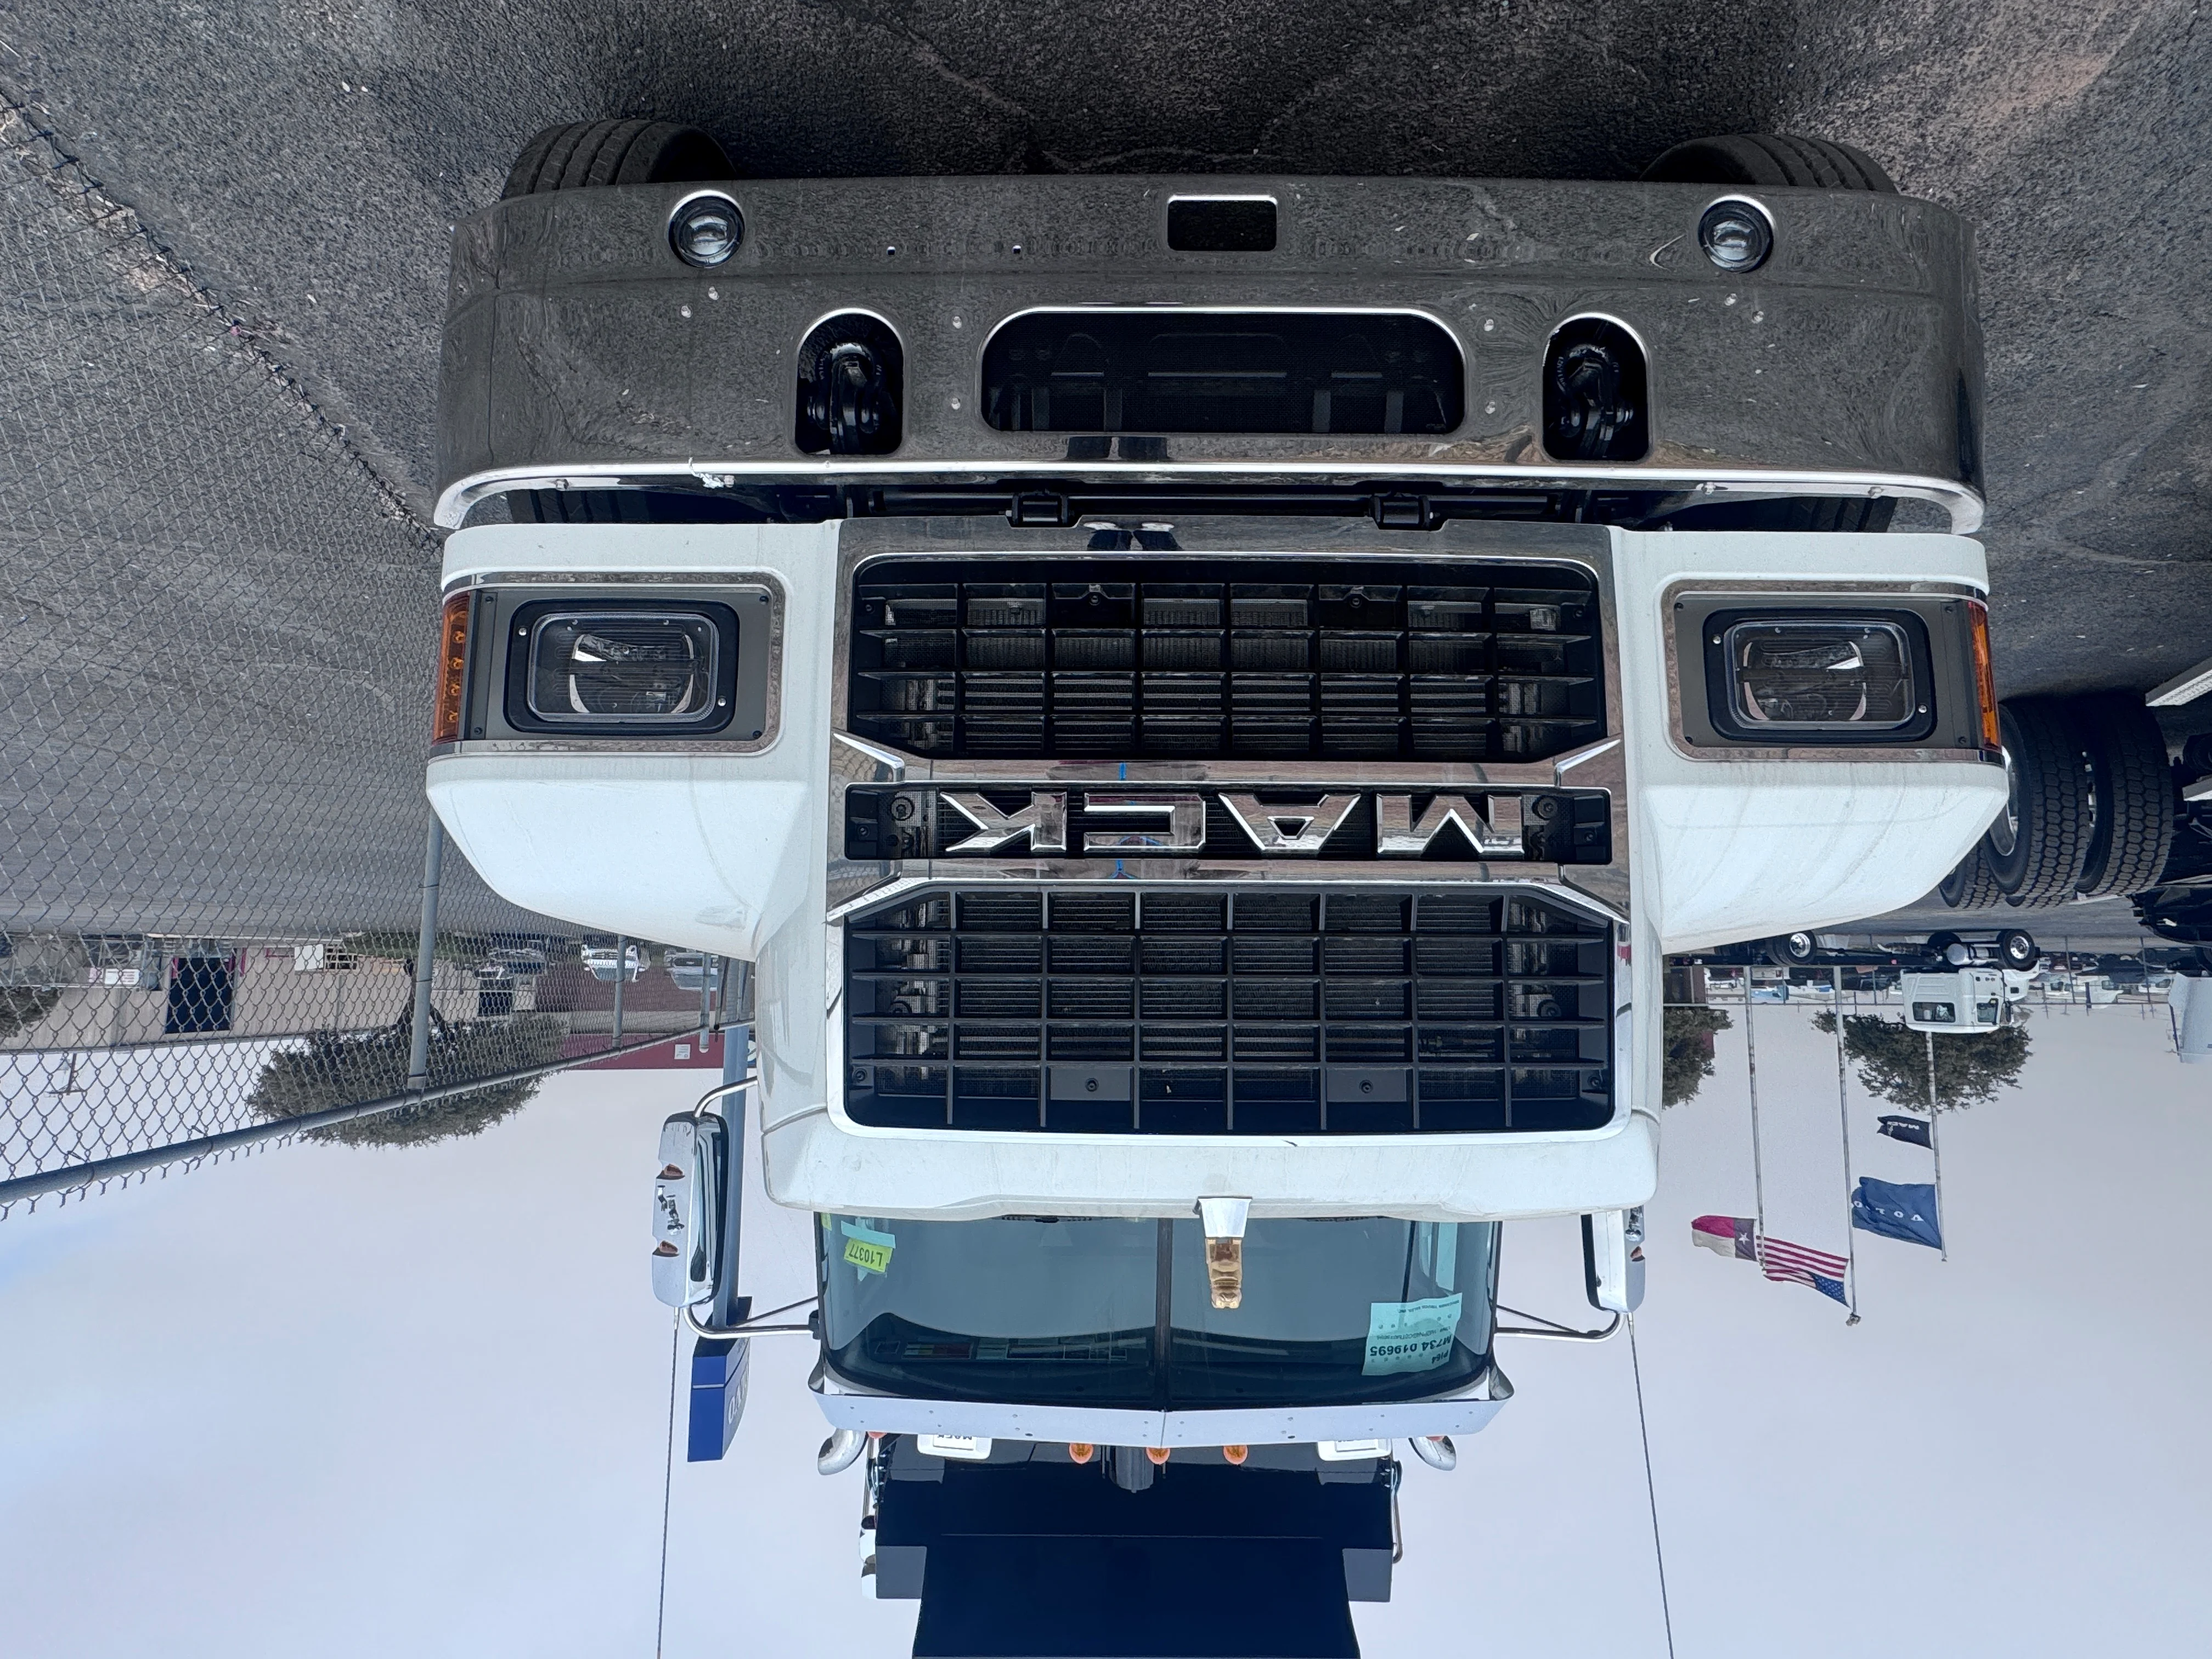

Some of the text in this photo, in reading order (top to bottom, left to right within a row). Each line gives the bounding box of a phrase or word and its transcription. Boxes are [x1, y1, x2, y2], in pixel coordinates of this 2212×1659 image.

[939, 791, 1524, 855] MACK
[848, 1244, 883, 1267] L10377
[1370, 1343, 1417, 1356] 019695
[1421, 1335, 1452, 1351] M734
